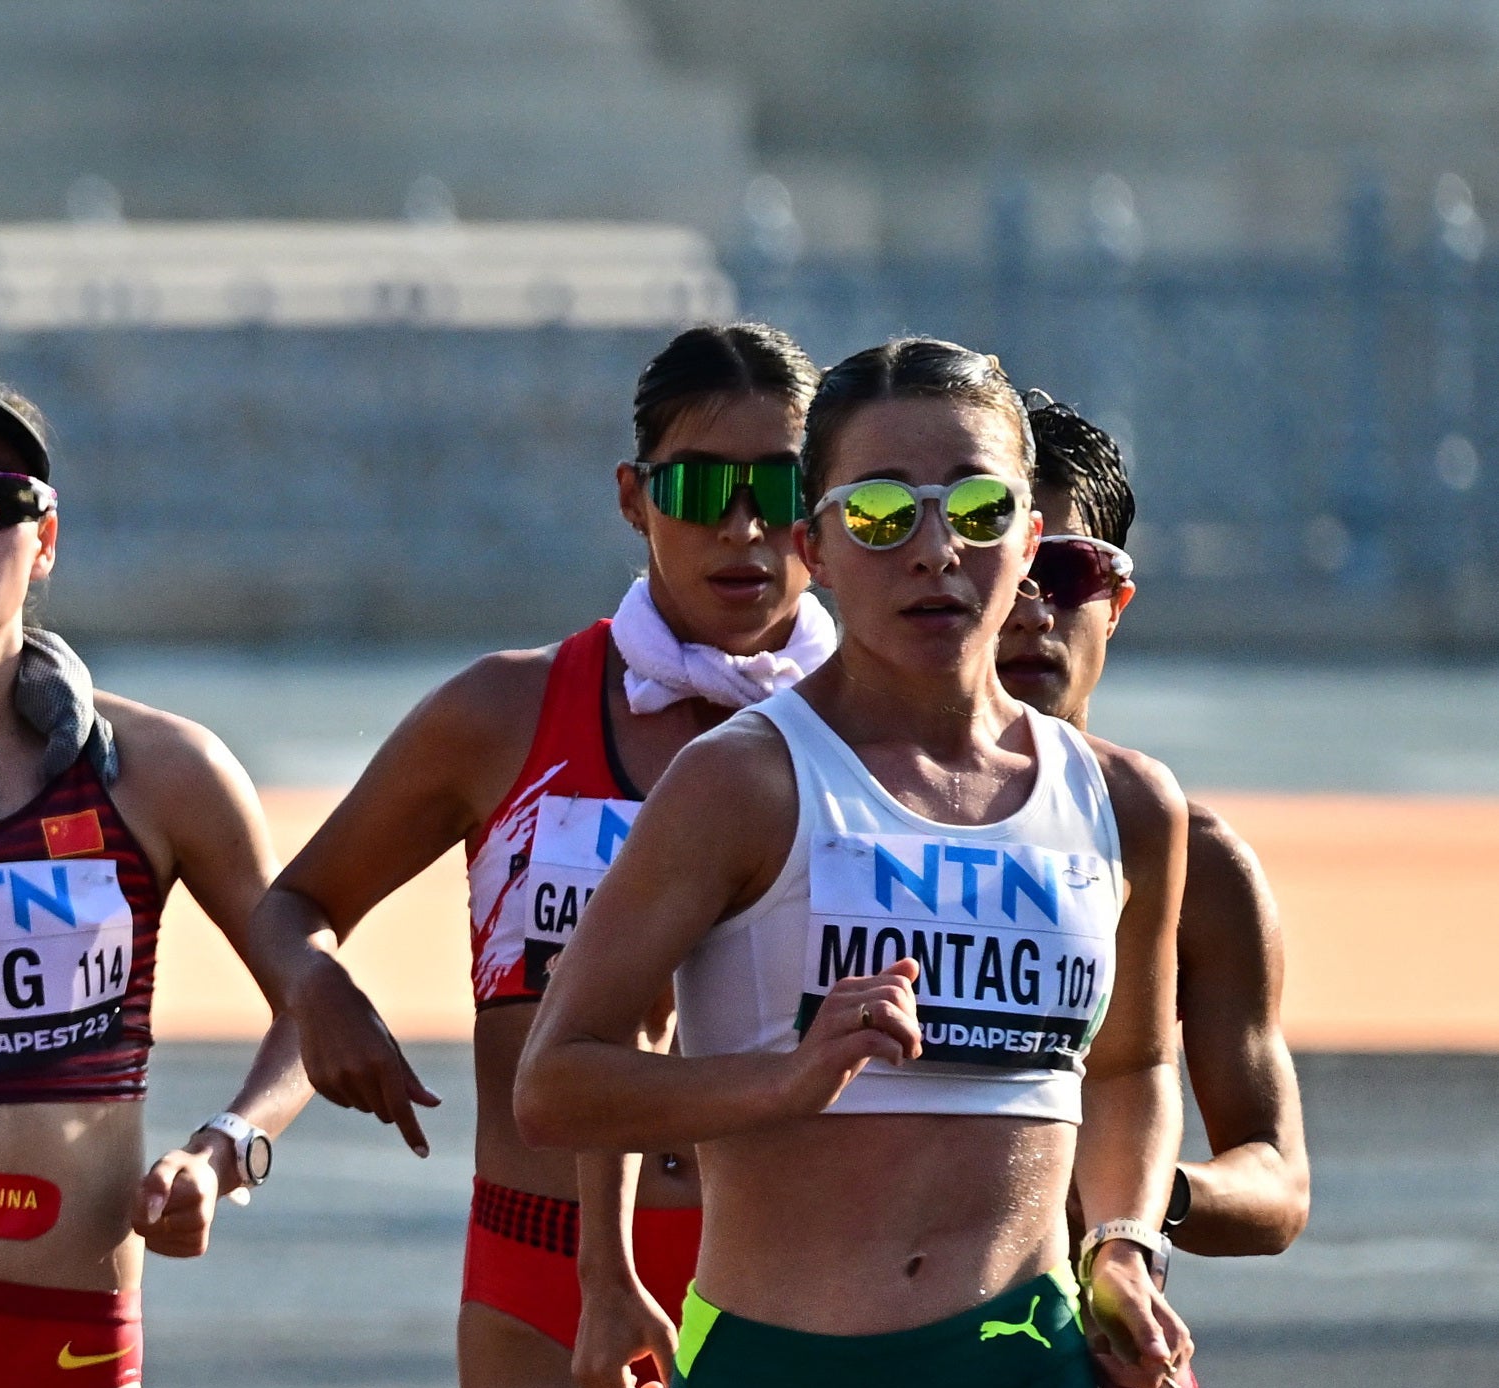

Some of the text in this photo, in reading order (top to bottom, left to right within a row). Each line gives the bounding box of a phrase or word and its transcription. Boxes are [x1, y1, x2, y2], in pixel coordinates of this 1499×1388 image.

[874, 842, 1059, 927] NTN
[78, 945, 124, 999] 114
[818, 923, 1096, 1009] MONTAG 101
[84, 1014, 109, 1038] 23
[918, 1021, 1045, 1054] UDAPEST
